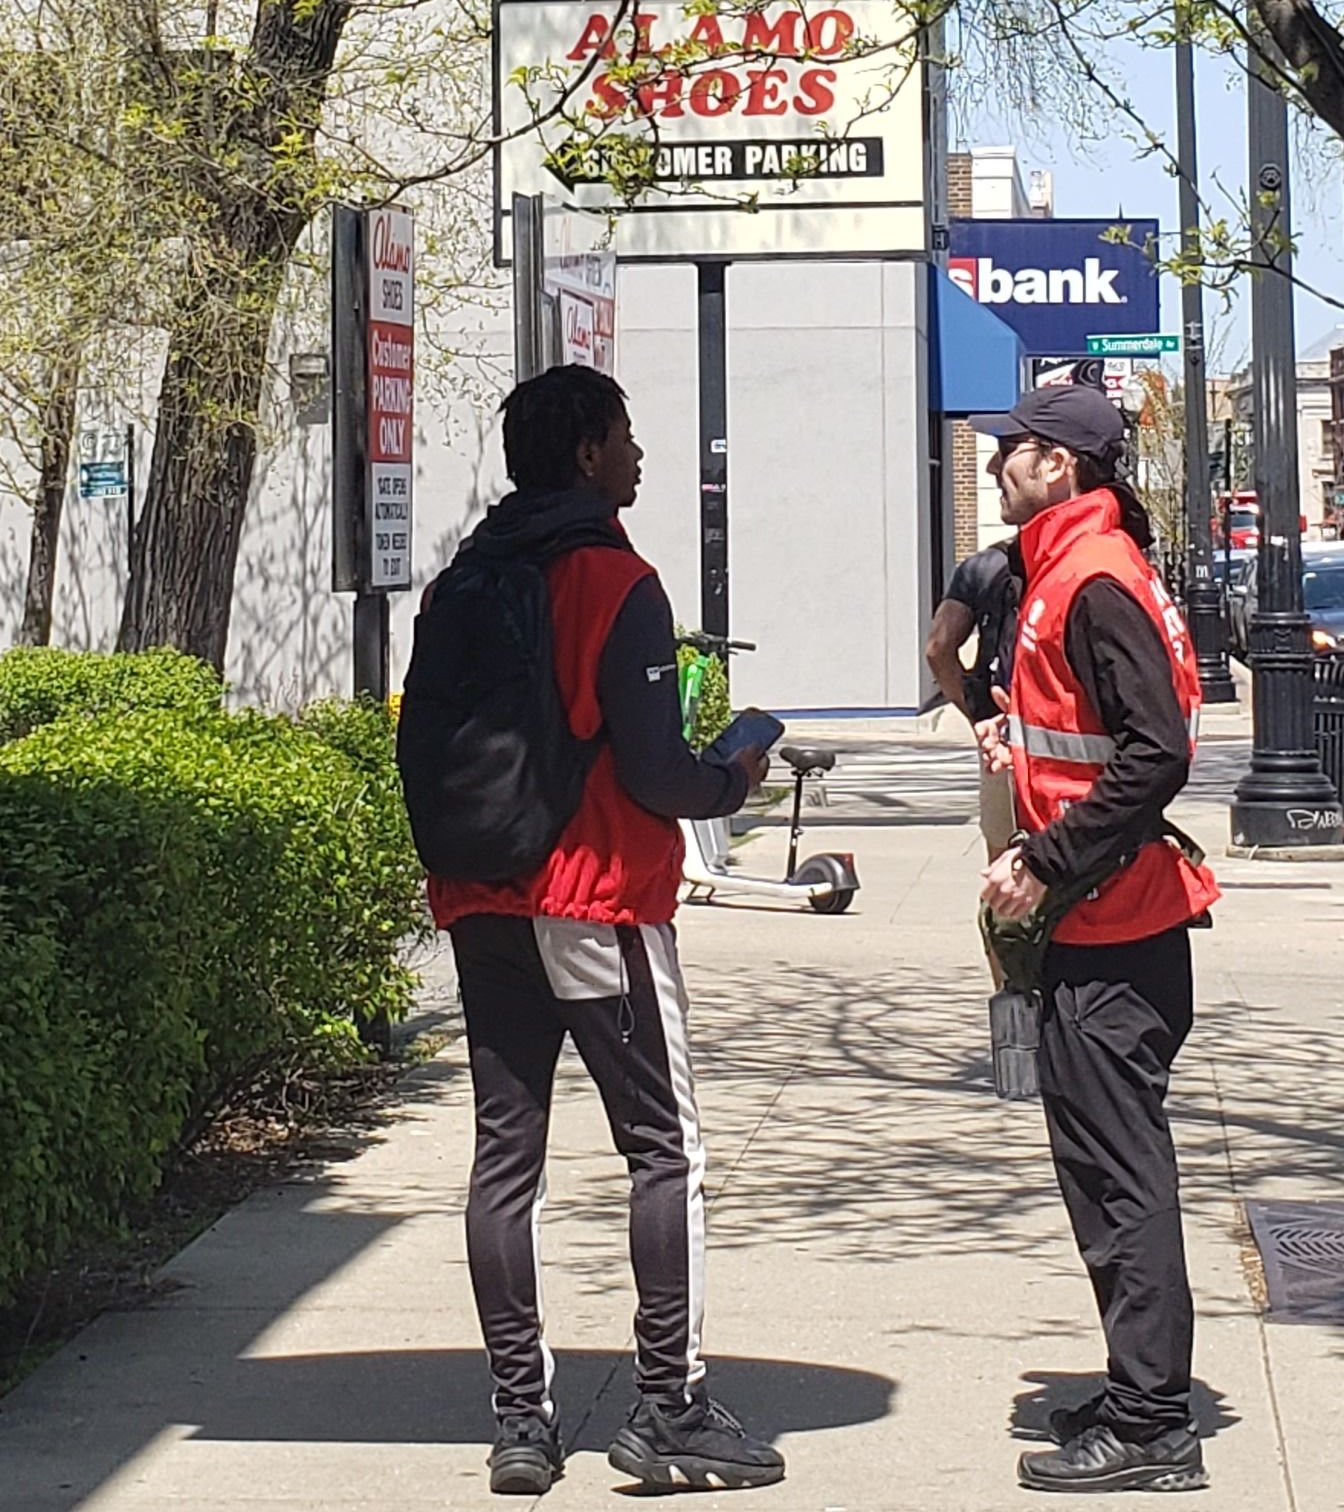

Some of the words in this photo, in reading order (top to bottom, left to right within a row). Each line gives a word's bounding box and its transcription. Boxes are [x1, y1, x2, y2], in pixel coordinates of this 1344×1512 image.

[565, 9, 856, 62] ALAMO
[584, 68, 838, 119] SHOES
[744, 142, 868, 176] PARKING
[382, 278, 404, 311] SHOES
[372, 329, 412, 372] Customer
[1102, 338, 1163, 352] Summerdale
[372, 375, 413, 414] PARKING
[379, 417, 406, 456] ONLY
